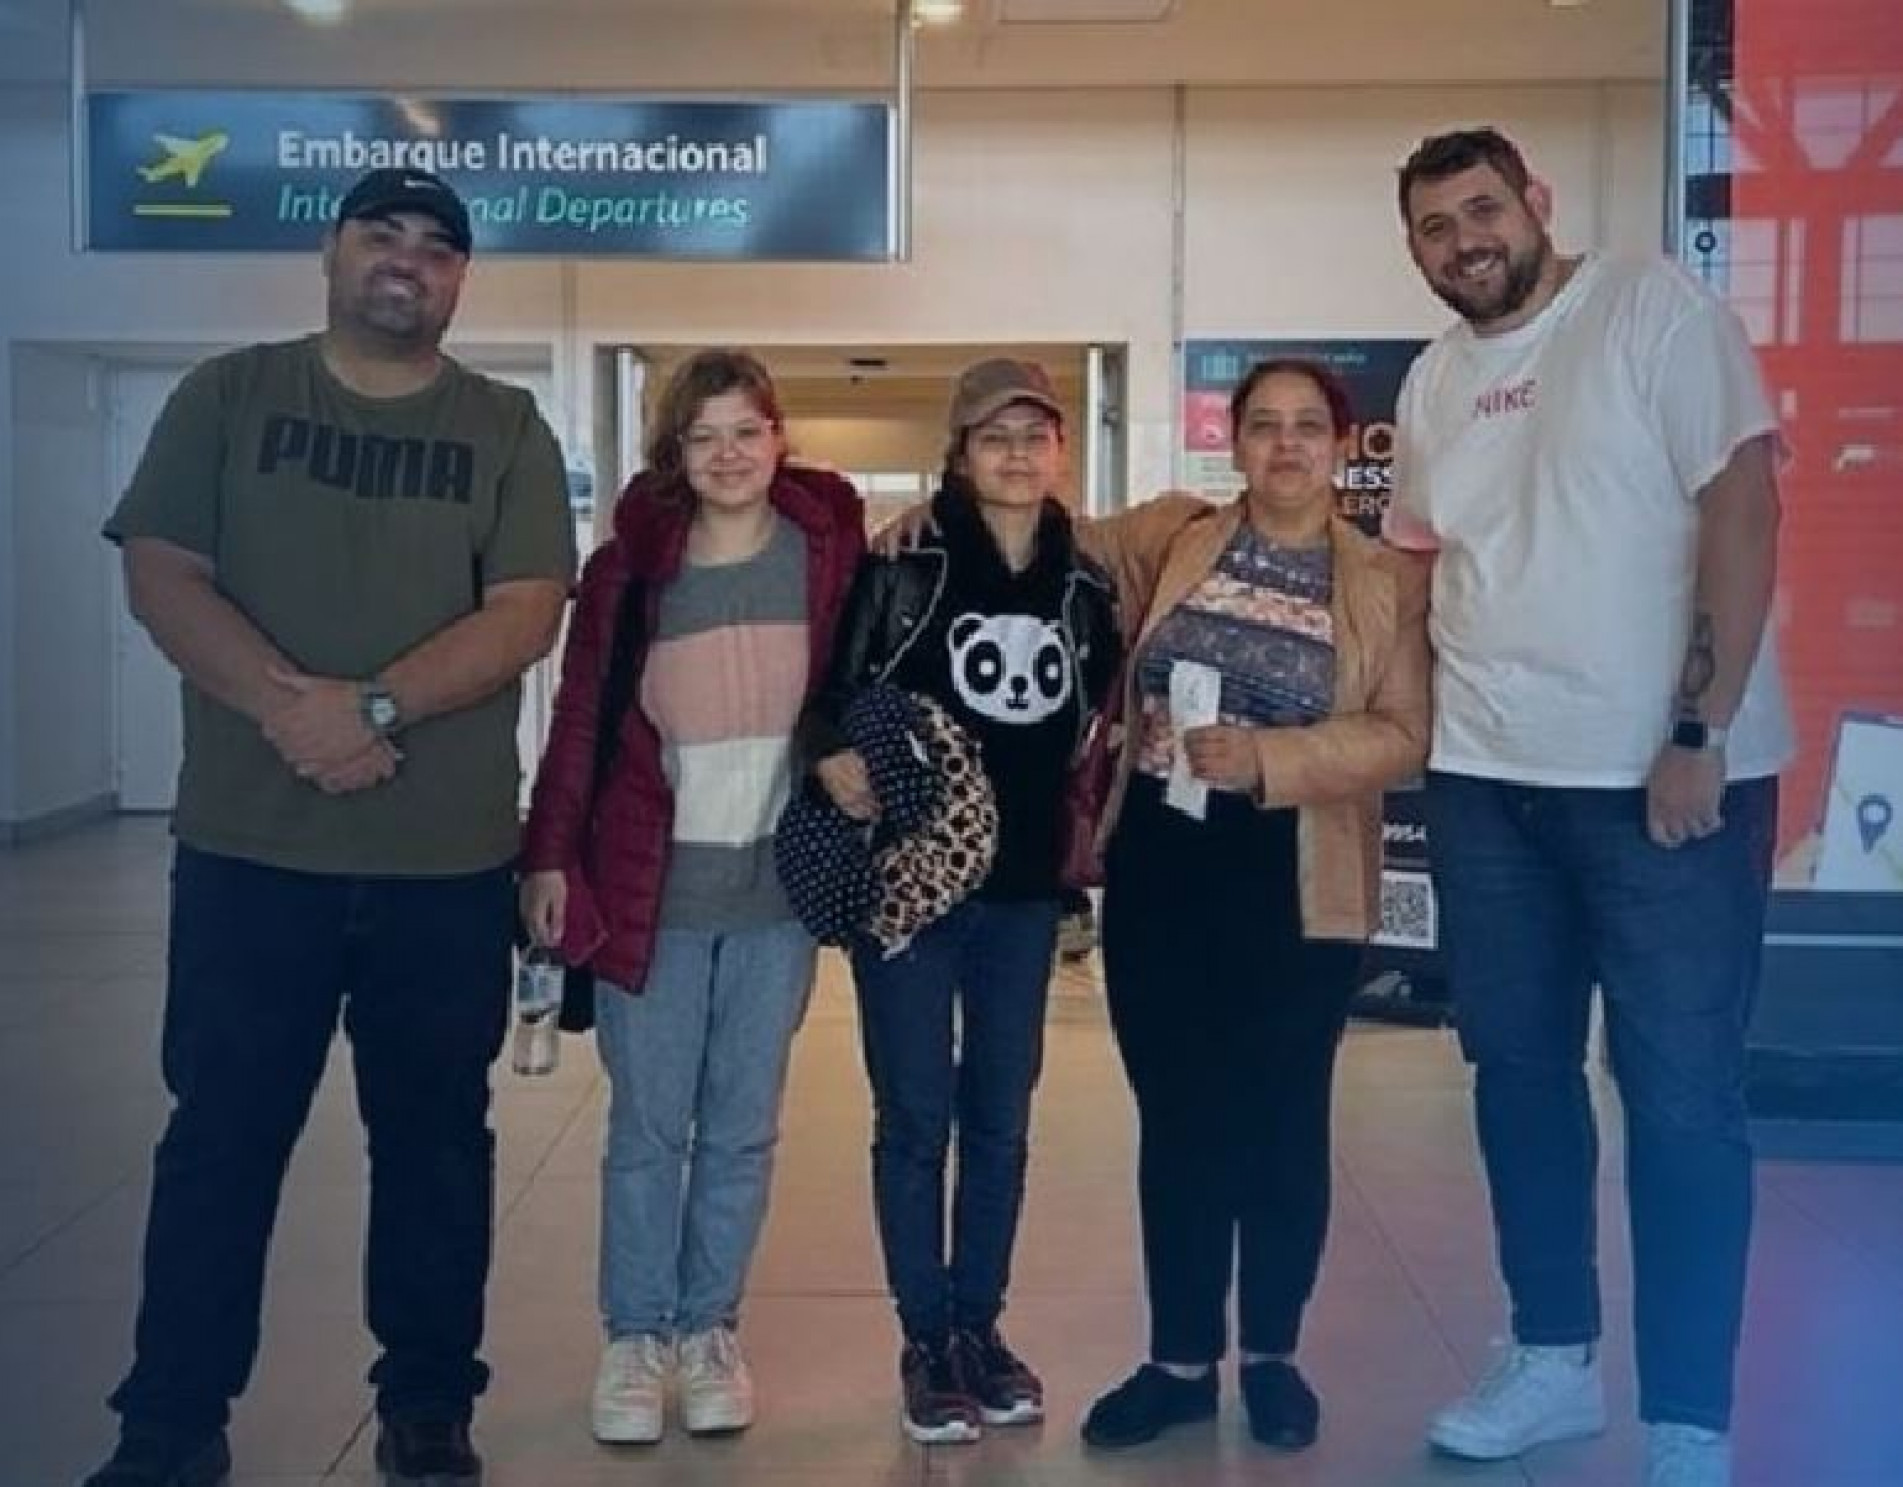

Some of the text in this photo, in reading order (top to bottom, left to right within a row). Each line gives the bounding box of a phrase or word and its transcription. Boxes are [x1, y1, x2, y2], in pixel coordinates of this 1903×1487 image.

[278, 131, 767, 174] Embarque Internacional
[535, 186, 749, 232] Departures
[257, 415, 474, 504] PUMA
